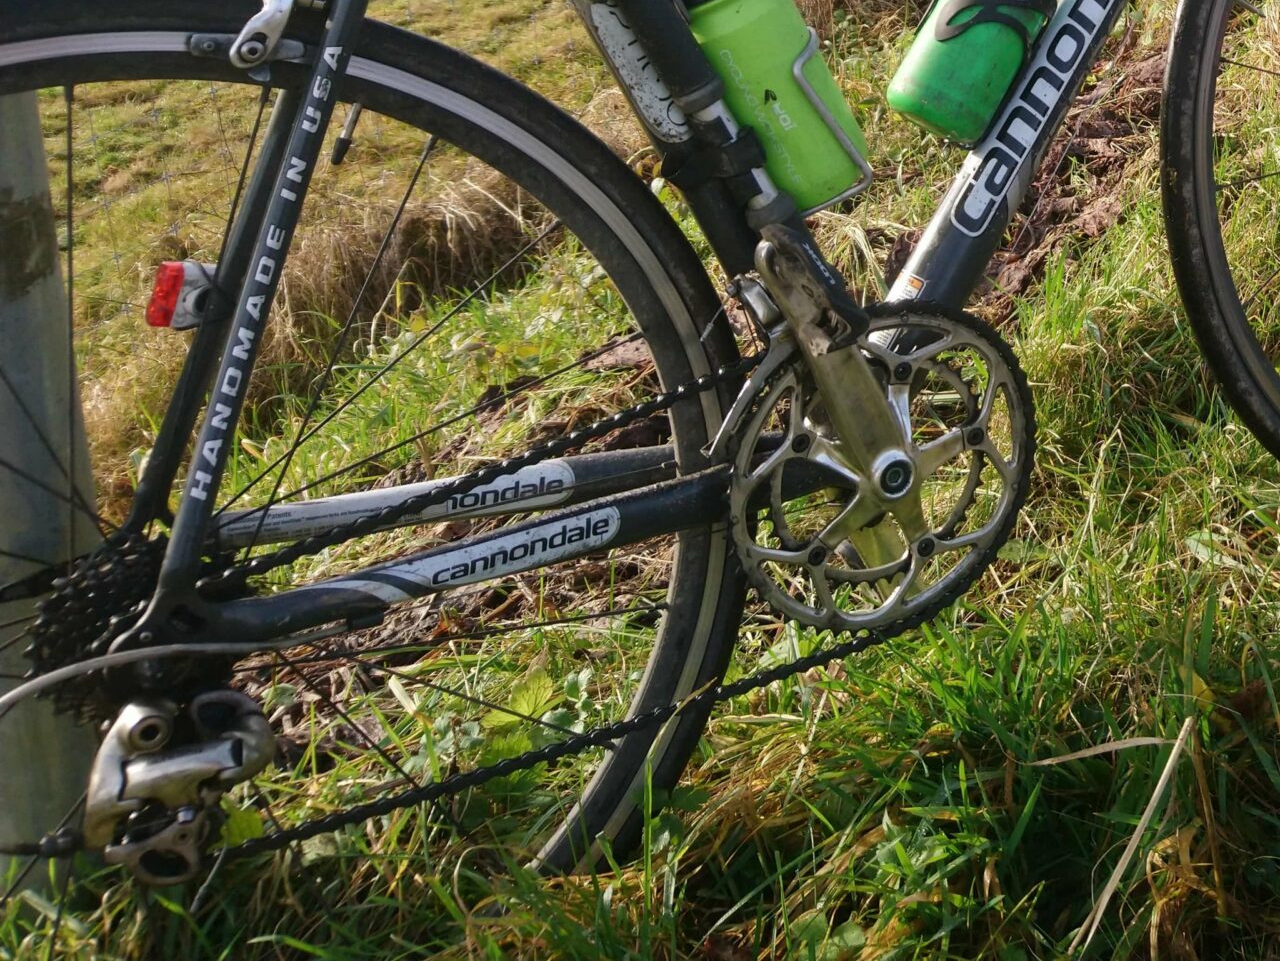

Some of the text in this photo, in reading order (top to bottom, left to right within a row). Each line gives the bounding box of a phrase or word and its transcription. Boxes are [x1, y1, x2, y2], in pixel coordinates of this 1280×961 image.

[189, 224, 286, 502] HANDMADE
[280, 156, 308, 203] IN
[300, 45, 344, 134] USA
[802, 242, 836, 285] LOOK
[431, 517, 610, 586] cannondale
